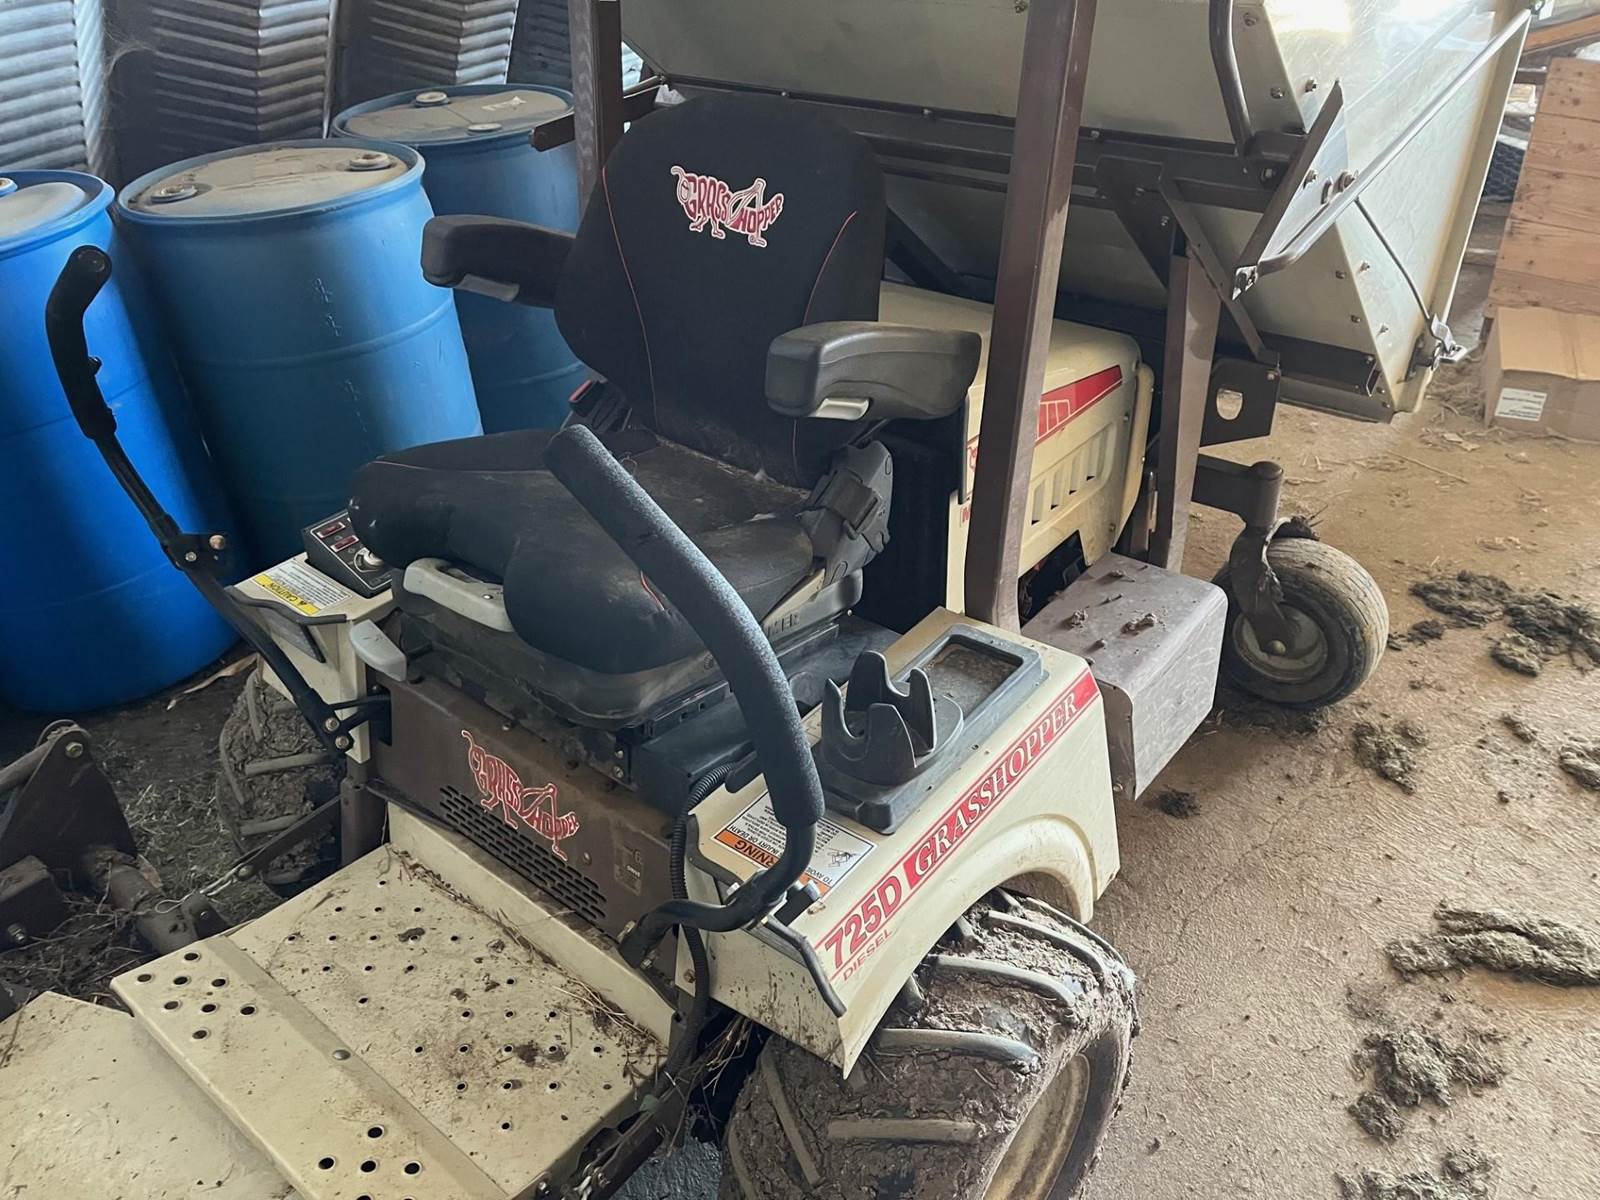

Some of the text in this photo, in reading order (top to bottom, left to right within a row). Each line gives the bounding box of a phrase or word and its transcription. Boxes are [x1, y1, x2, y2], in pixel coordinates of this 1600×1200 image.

[764, 611, 800, 640] MER
[824, 691, 1078, 969] 725D GRASSHOPPER
[734, 840, 776, 867] RNING
[842, 929, 893, 981] DIESEL
